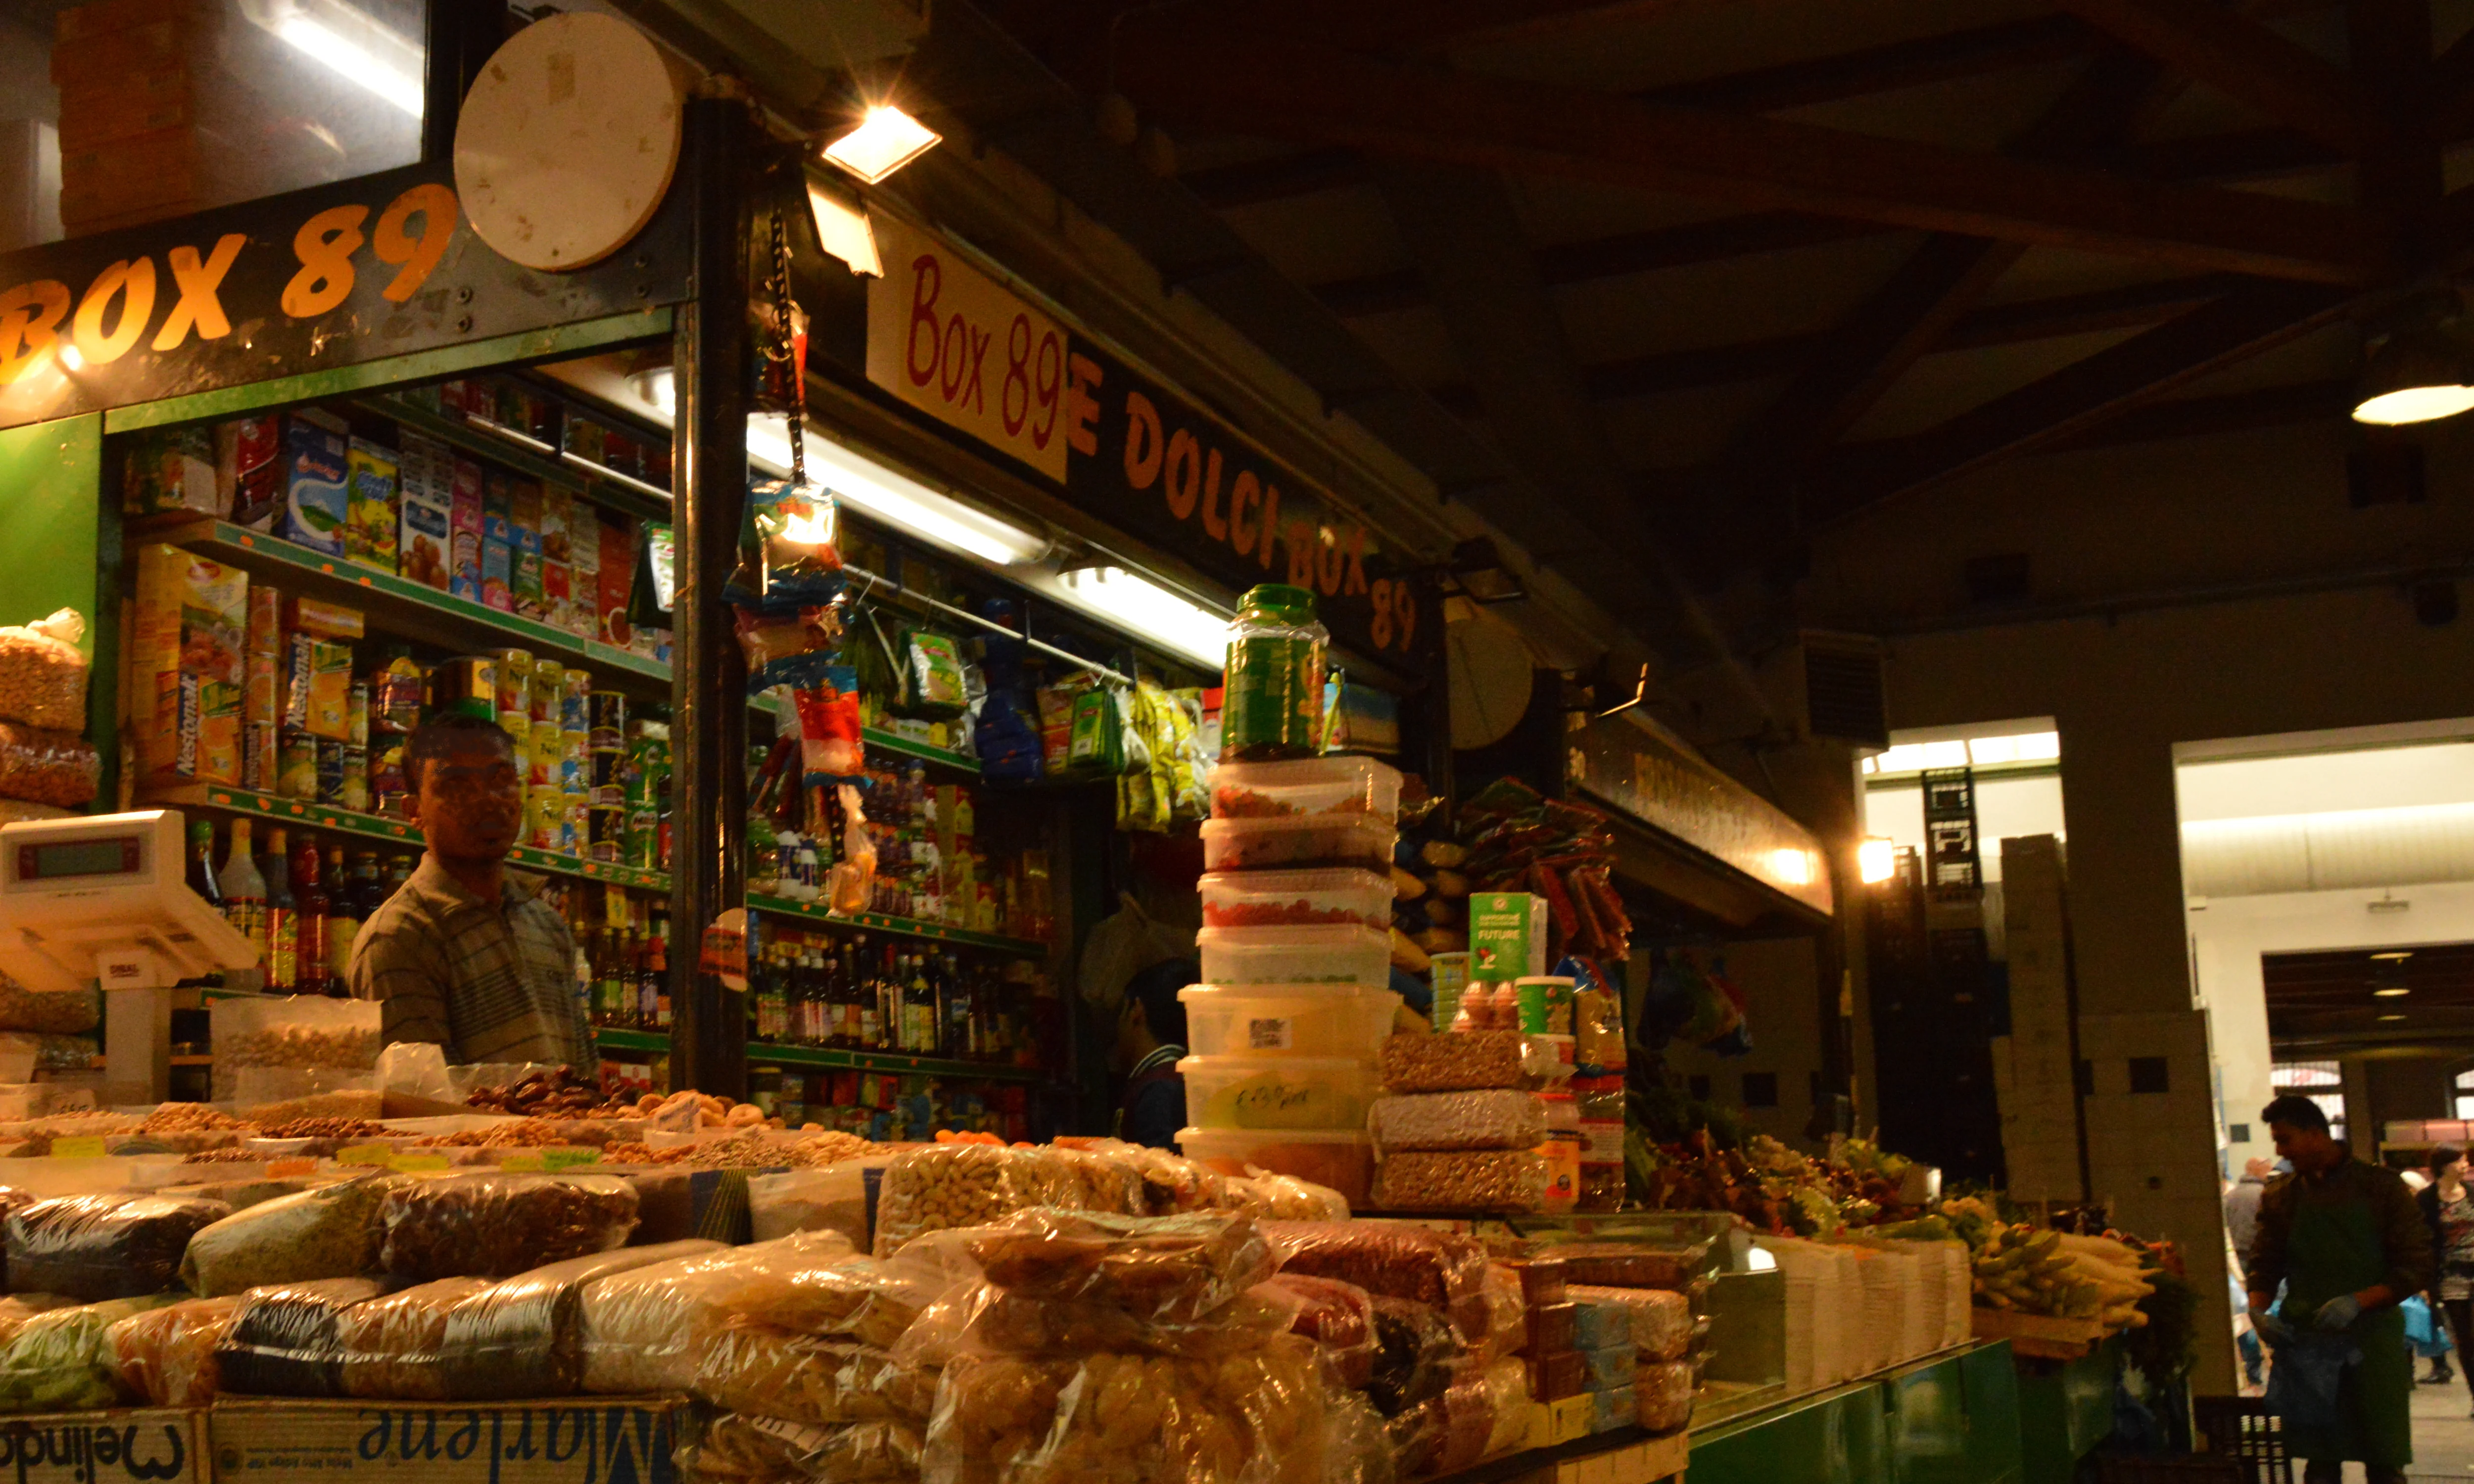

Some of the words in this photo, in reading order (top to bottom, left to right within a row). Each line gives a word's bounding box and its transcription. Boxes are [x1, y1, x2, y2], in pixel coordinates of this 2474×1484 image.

[0, 233, 247, 384] BOX
[281, 183, 458, 319] 89
[907, 253, 992, 418] Box
[1001, 313, 1062, 450] 89
[1123, 390, 1280, 570] DOLCI
[1285, 520, 1369, 598] BOX
[1369, 578, 1416, 652] 89
[358, 1408, 673, 1484] Marlene
